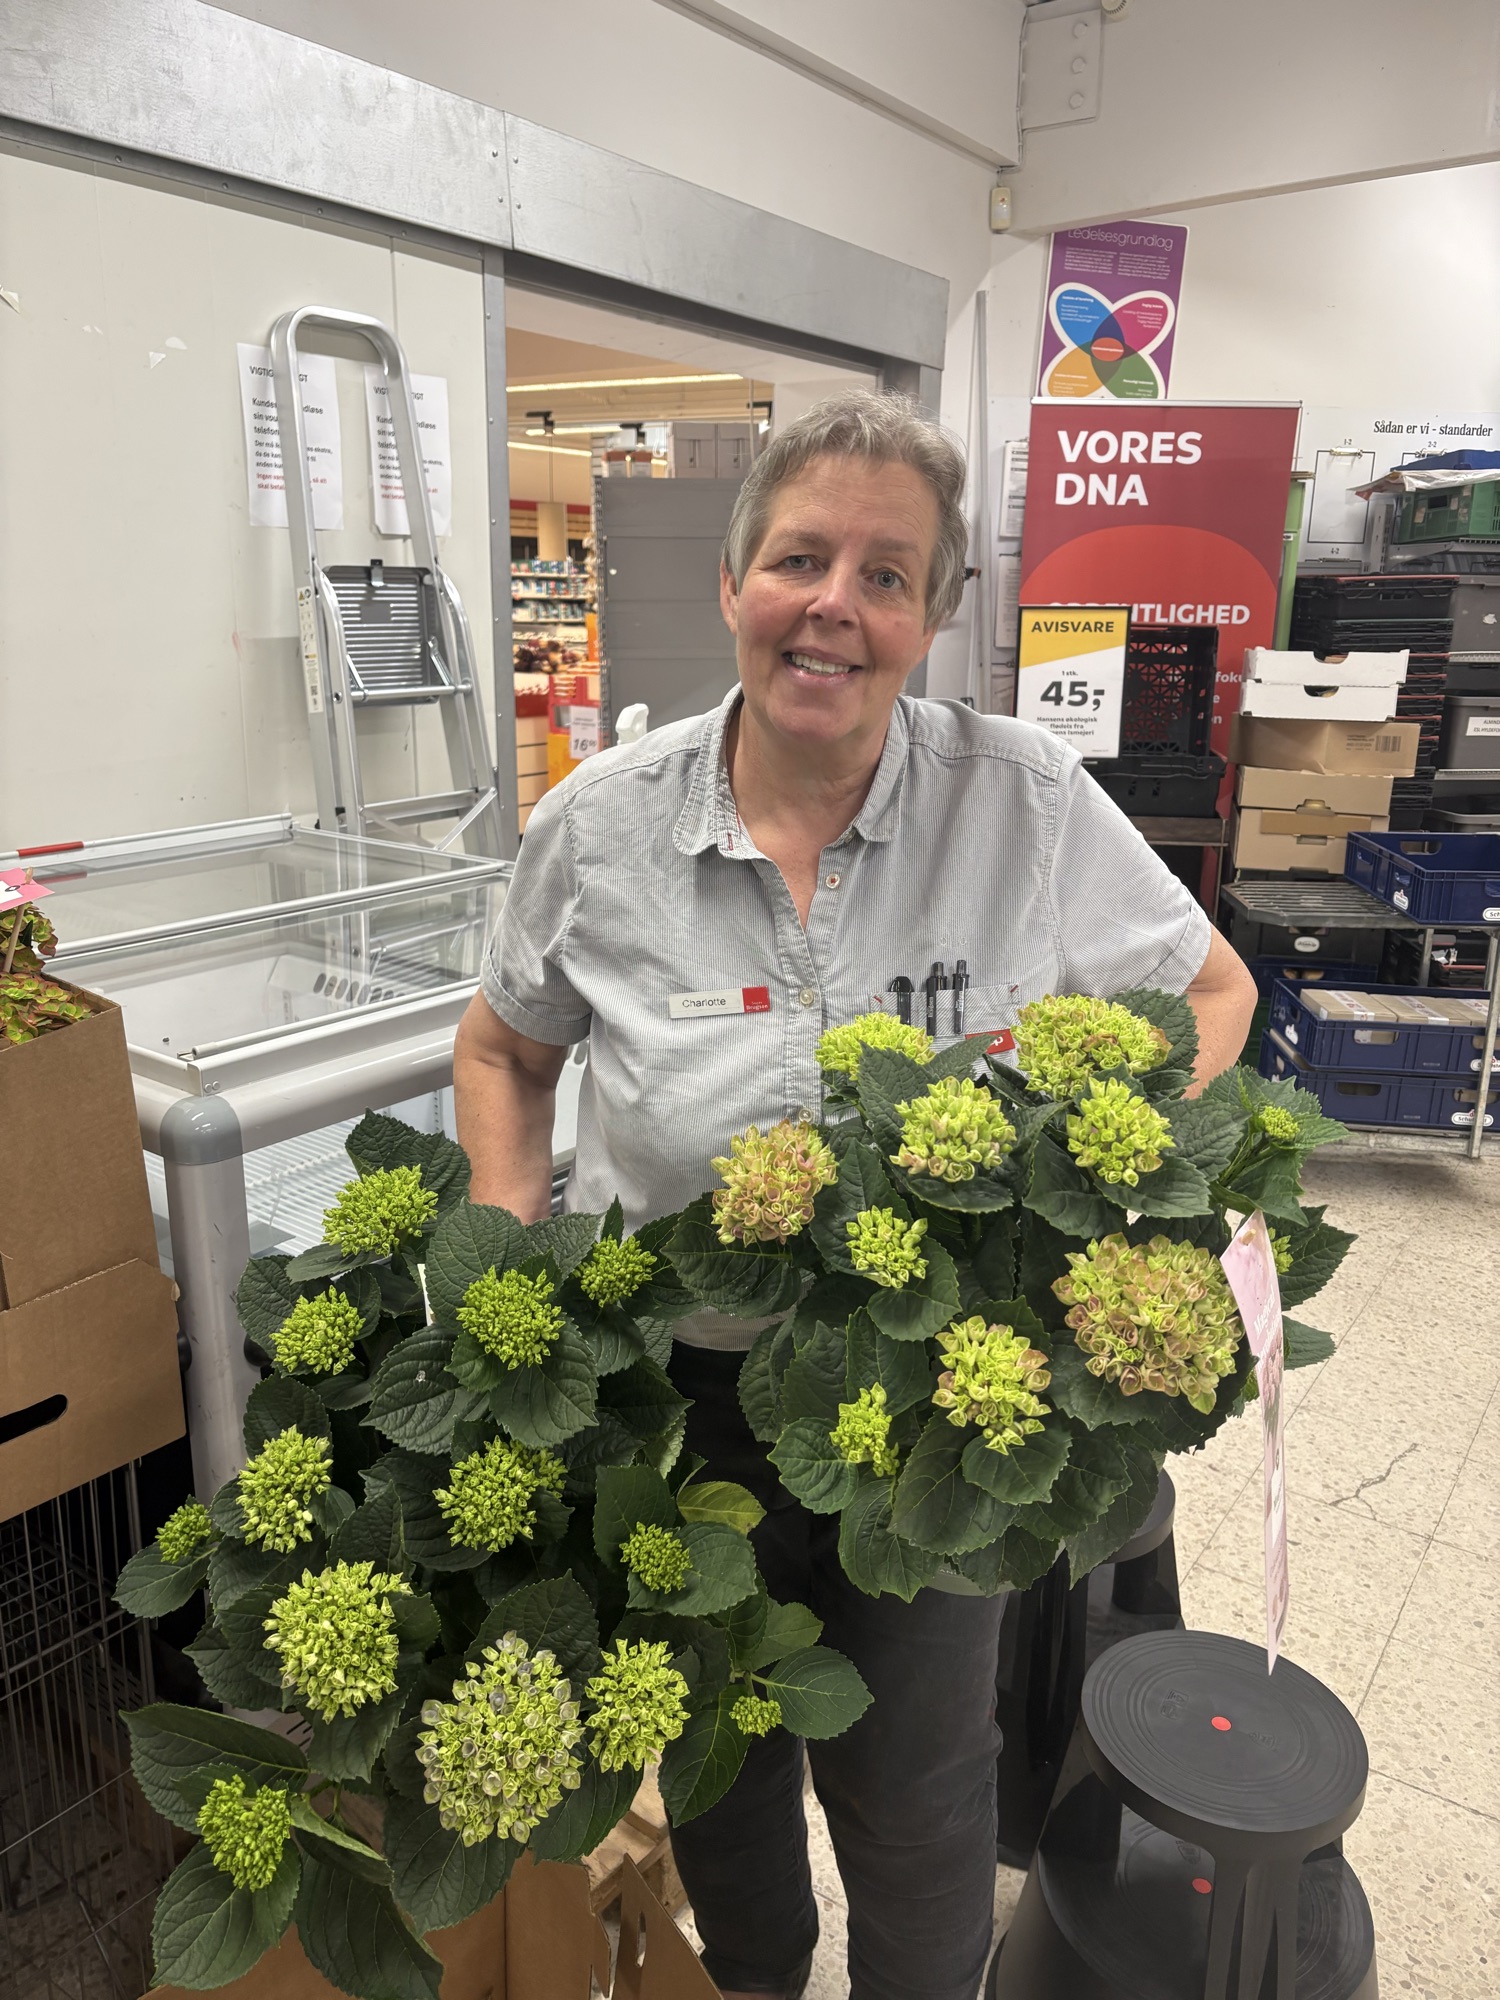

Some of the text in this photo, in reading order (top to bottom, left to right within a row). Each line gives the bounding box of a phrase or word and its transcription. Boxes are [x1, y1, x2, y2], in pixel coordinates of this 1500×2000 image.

[1068, 228, 1173, 251] Ledelsesgrundlag
[249, 366, 274, 377] VIGTIG
[1374, 421, 1403, 434] Sådan
[1406, 424, 1417, 434] er
[1420, 422, 1430, 435] vi
[1439, 424, 1493, 437] standarder
[1057, 430, 1203, 465] VORES
[1055, 473, 1149, 506] DNA
[1031, 621, 1114, 633] AVISVARE
[682, 999, 726, 1008] Charlotte
